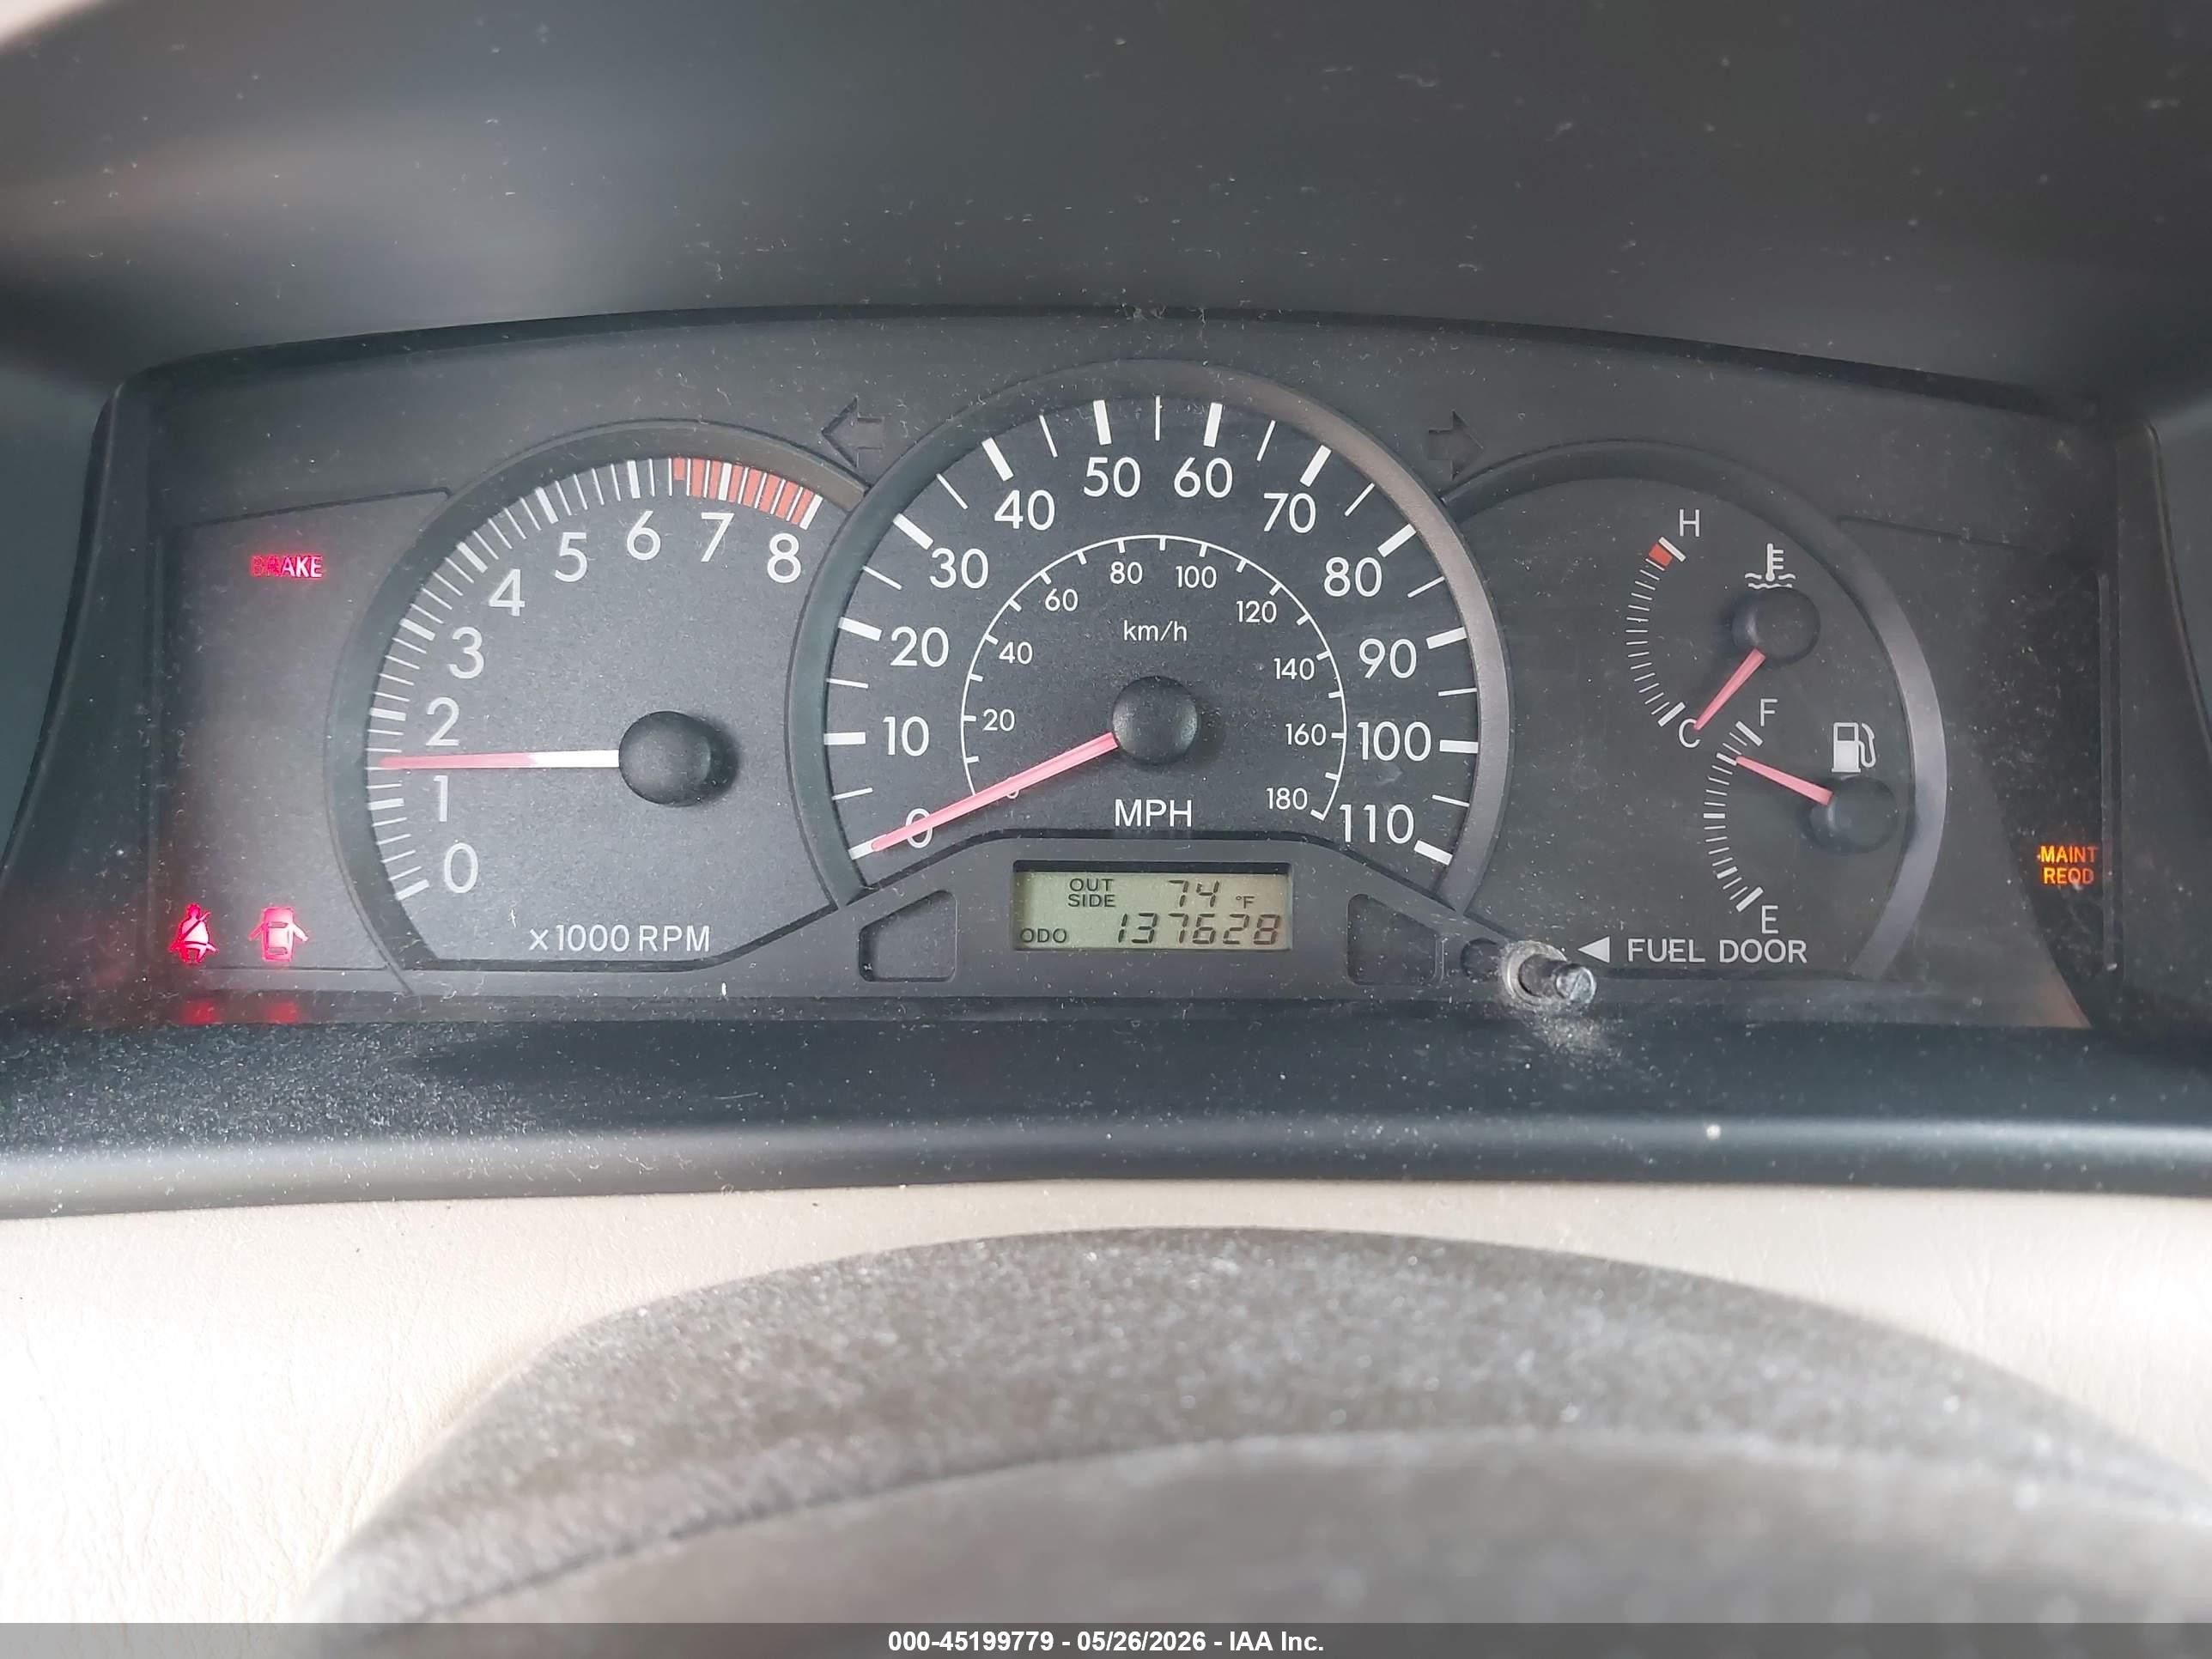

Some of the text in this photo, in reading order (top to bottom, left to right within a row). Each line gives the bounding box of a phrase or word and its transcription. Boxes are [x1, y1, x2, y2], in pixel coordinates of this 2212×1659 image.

[1083, 456, 1141, 498] 50
[1174, 457, 1233, 498] 60
[994, 489, 1055, 531] 40
[1263, 492, 1316, 533] 70
[1679, 508, 1700, 538] H
[626, 510, 661, 561] 6
[700, 512, 735, 562] 7
[554, 532, 588, 582] 5
[767, 532, 801, 584] 8
[928, 546, 989, 589] 30
[1109, 561, 1143, 585] 80
[1176, 565, 1217, 589] 100
[1323, 556, 1382, 598] 80
[487, 568, 526, 617] 4
[1044, 587, 1079, 612] 60
[1236, 600, 1277, 623] 120
[1122, 619, 1188, 642] km/h
[447, 626, 484, 679] 3
[890, 626, 950, 668] 20
[998, 640, 1033, 665] 40
[1358, 638, 1417, 679] 90
[1273, 658, 1315, 681] 140
[425, 696, 459, 746] 2
[982, 708, 1015, 732] 20
[1759, 698, 1778, 727] F
[882, 715, 929, 757] 10
[1285, 723, 1327, 746] 160
[1360, 723, 1431, 762] 100
[1678, 718, 1701, 749] C
[433, 775, 448, 823] 1
[1115, 799, 1192, 828] MPH
[1266, 787, 1308, 811] 180
[1343, 804, 1414, 844] 110
[443, 842, 479, 894] 0
[2040, 845, 2099, 863] MAINT
[1069, 878, 1115, 891] OUT
[1168, 880, 1219, 908] 74
[1067, 893, 1115, 908] SIDE
[1019, 913, 1280, 945] ODO 137628
[1761, 904, 1779, 934] E
[638, 925, 710, 953] RPM
[1627, 938, 1808, 963] FUEL DOOR
